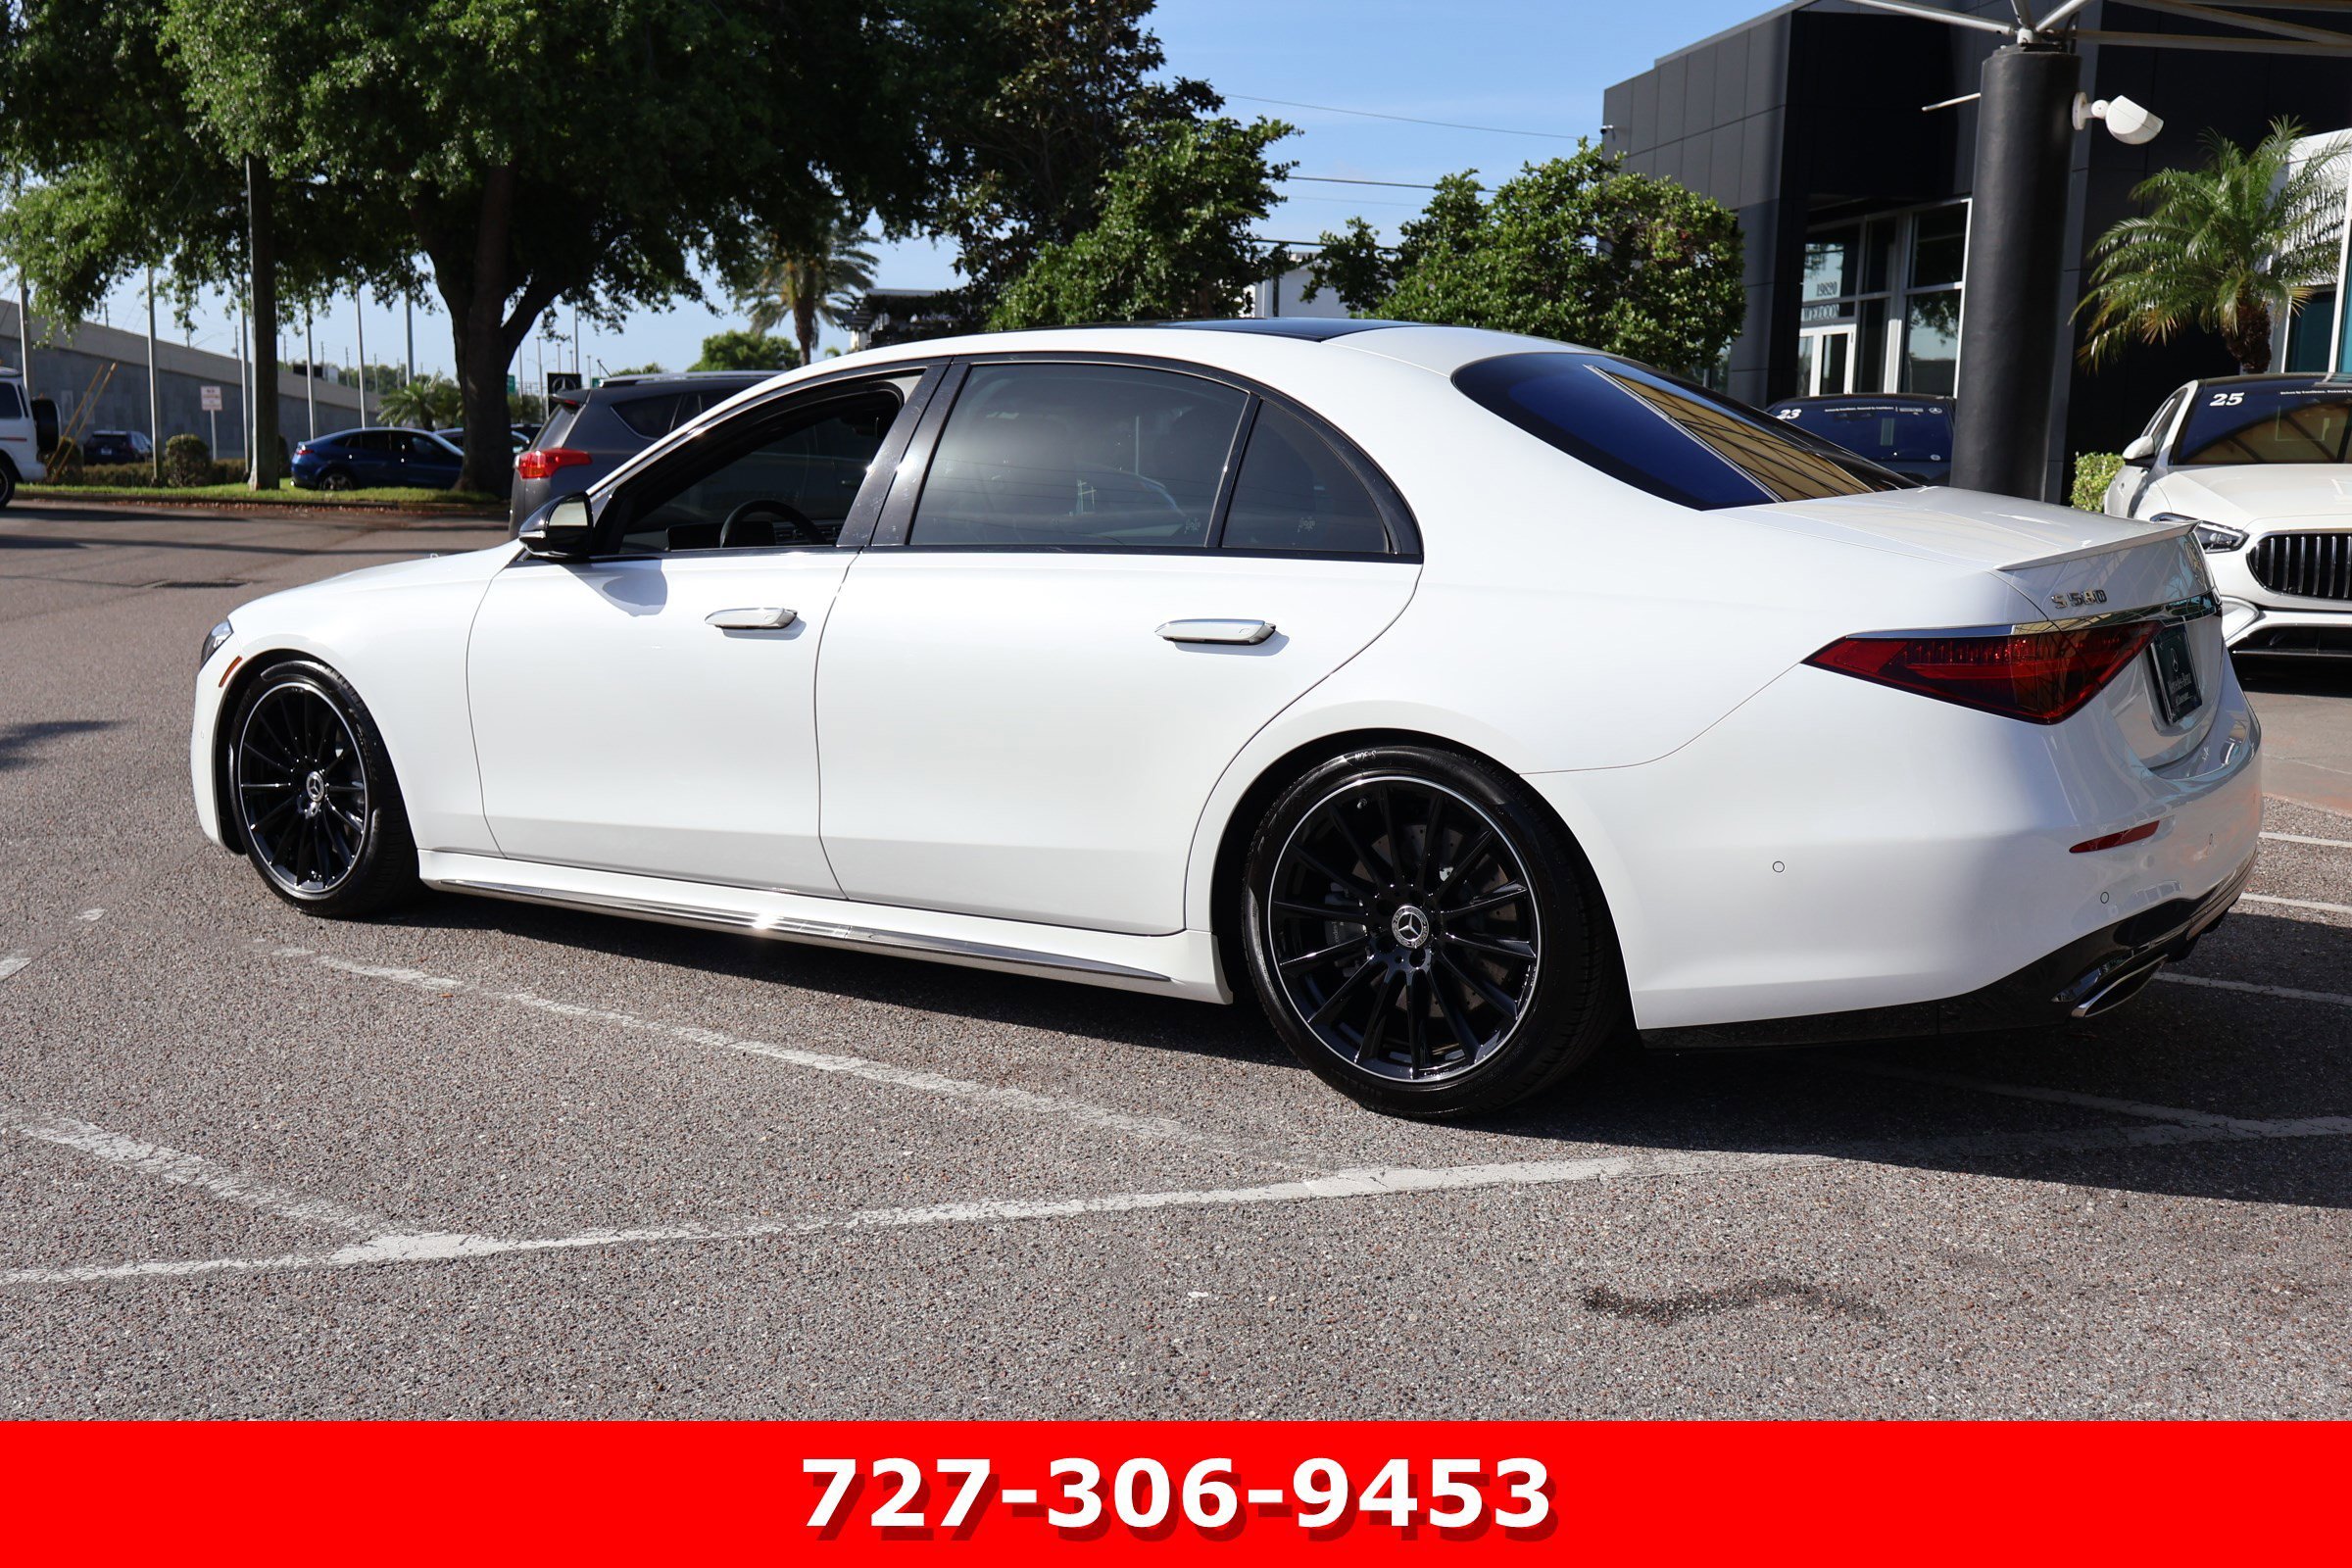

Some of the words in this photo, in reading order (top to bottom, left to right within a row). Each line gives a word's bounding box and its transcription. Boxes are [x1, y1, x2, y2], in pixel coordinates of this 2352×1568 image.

[2209, 392, 2245, 407] 25
[1775, 408, 1802, 421] 23
[2051, 595, 2068, 609] S
[2067, 589, 2107, 607] 580
